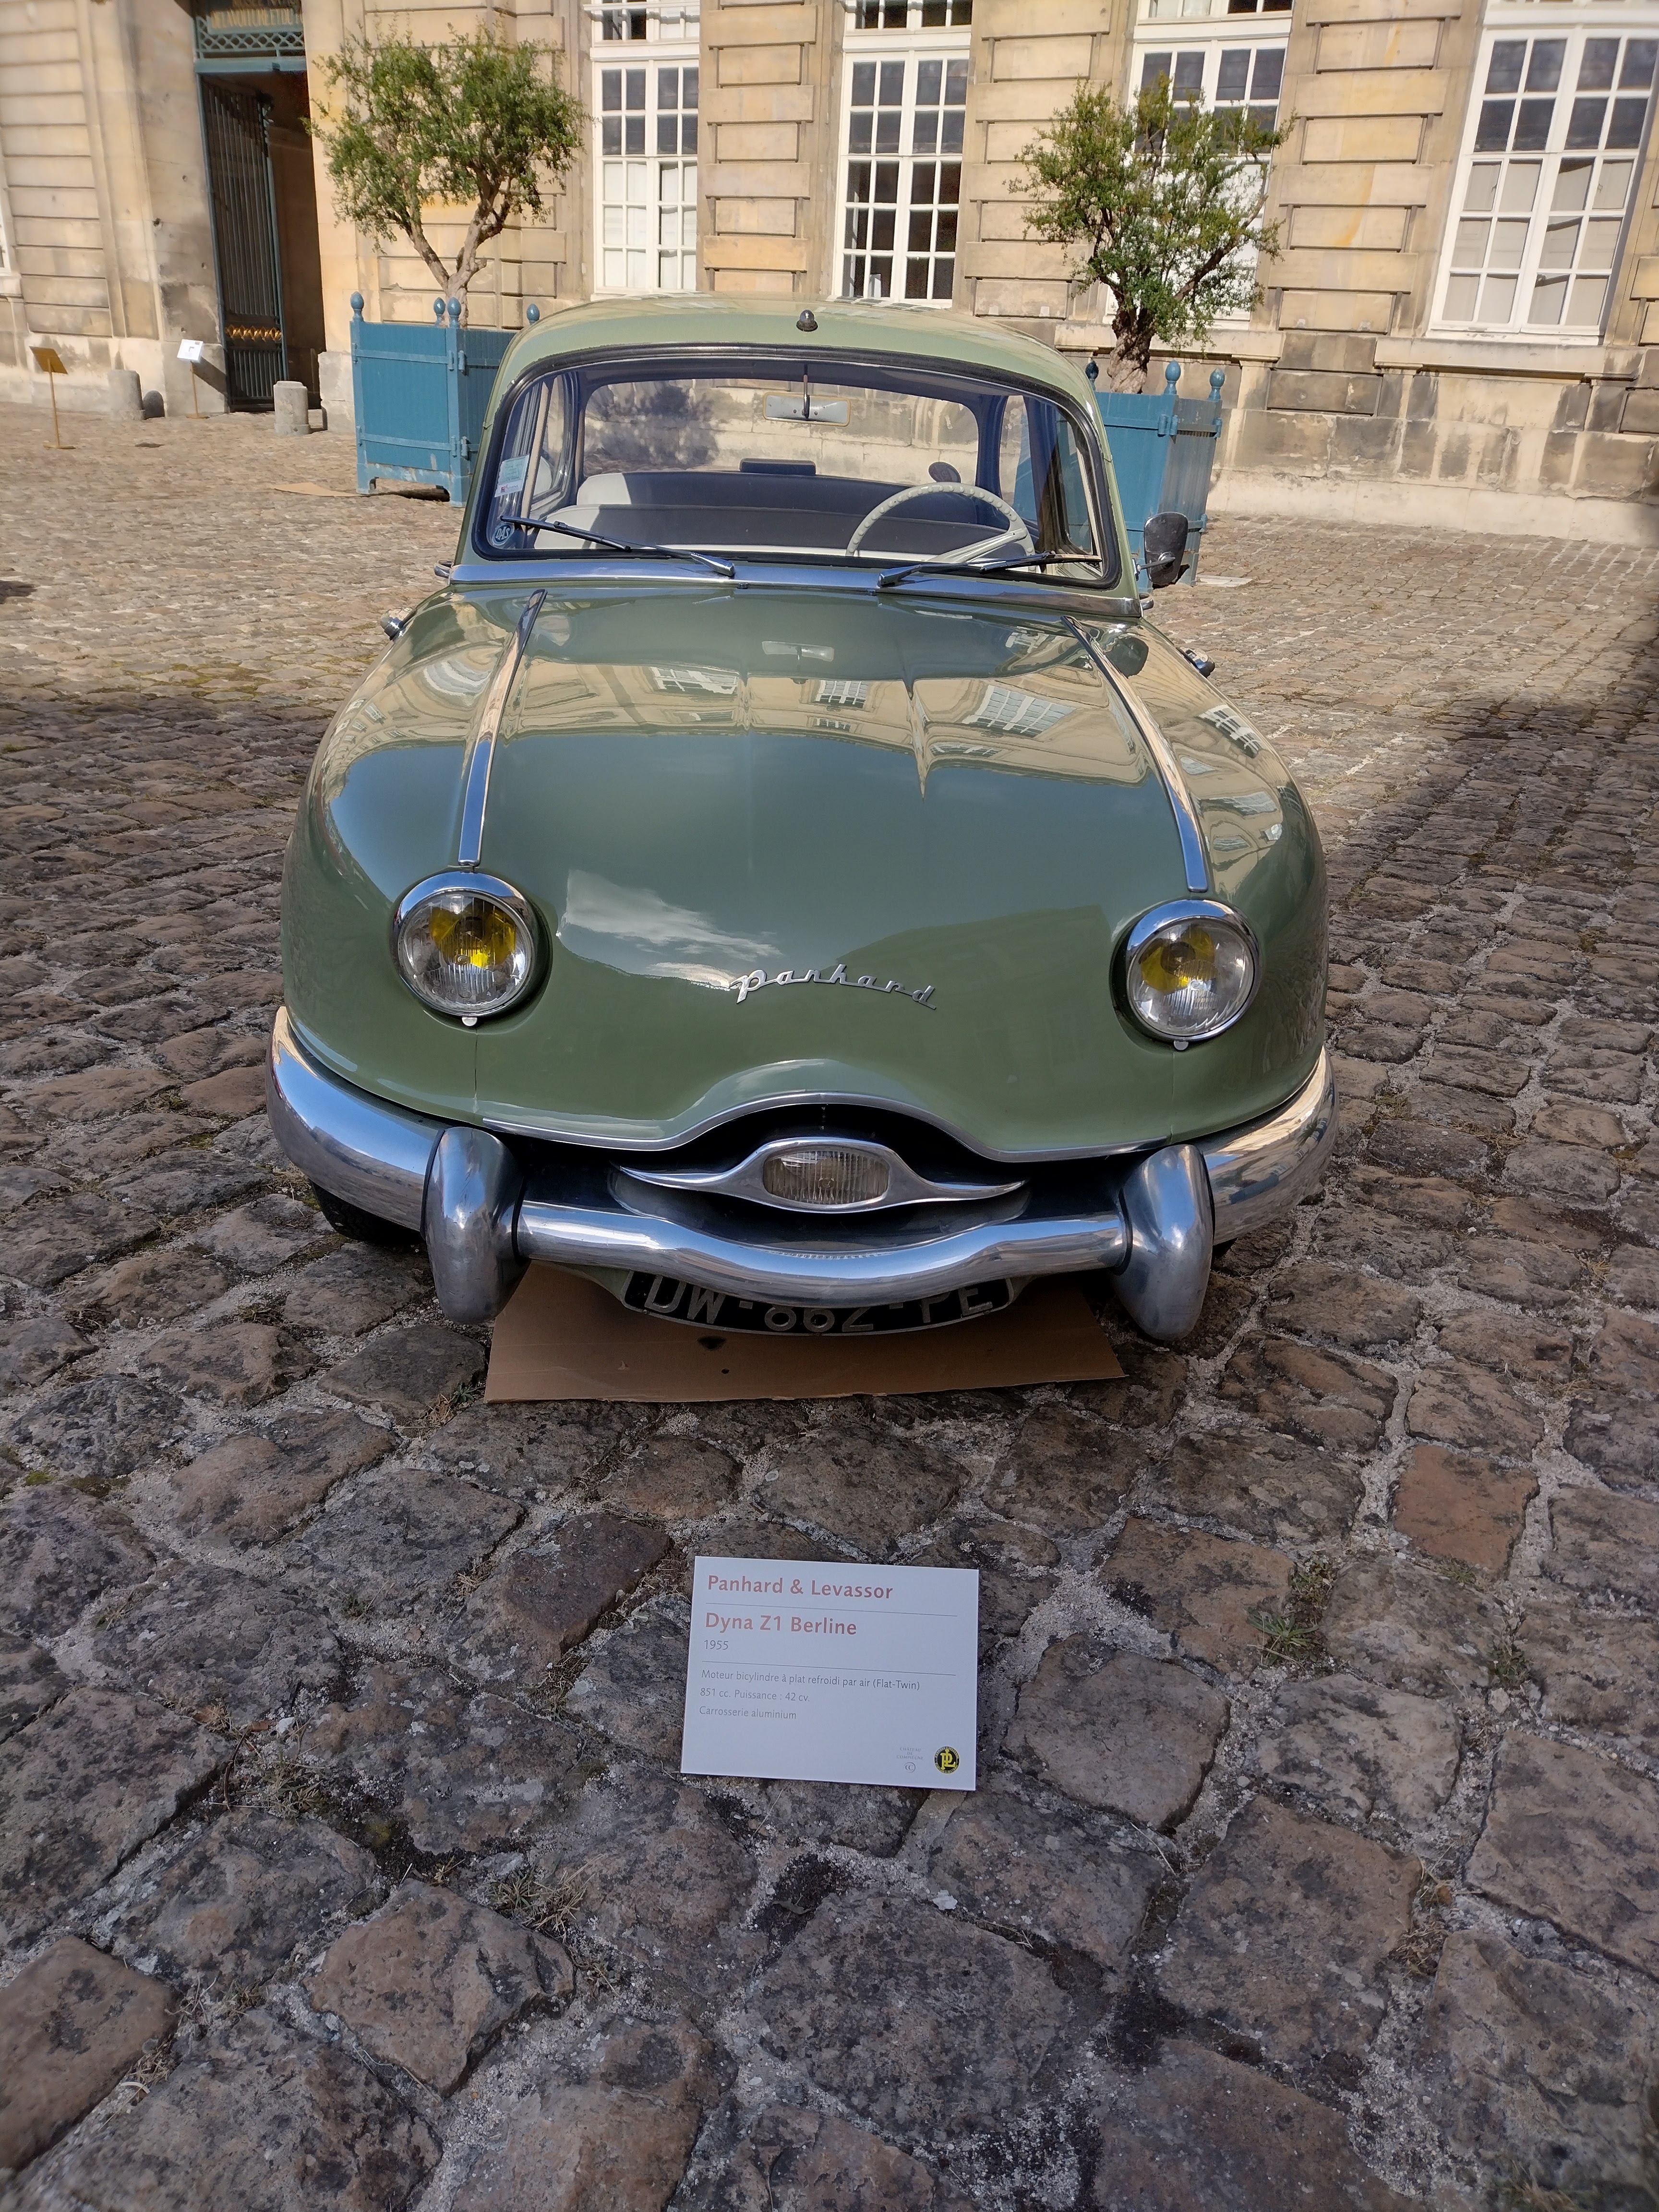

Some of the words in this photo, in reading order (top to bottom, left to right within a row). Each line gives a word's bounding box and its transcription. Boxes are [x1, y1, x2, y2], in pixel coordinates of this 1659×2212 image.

[495, 526, 510, 541] DAS
[708, 1575, 783, 1594] Panhard
[790, 1578, 804, 1595] &
[811, 1579, 893, 1599] Levassor
[705, 1612, 753, 1633] Dyna
[760, 1615, 781, 1631] Z1
[791, 1616, 857, 1635] Berline
[704, 1639, 729, 1650] 1955
[701, 1670, 734, 1680] Moteur
[736, 1671, 779, 1683] bicylindre
[781, 1674, 787, 1683] à
[789, 1674, 805, 1685] plat
[808, 1675, 840, 1685] refroidi
[842, 1679, 857, 1688] par
[859, 1678, 870, 1687] air
[873, 1679, 920, 1691] (Flat-Twin)
[700, 1687, 716, 1697] 851
[734, 1689, 777, 1700] Puissance
[785, 1692, 796, 1701] 42
[699, 1706, 749, 1717] Carrosserie
[751, 1708, 797, 1719] aluminium
